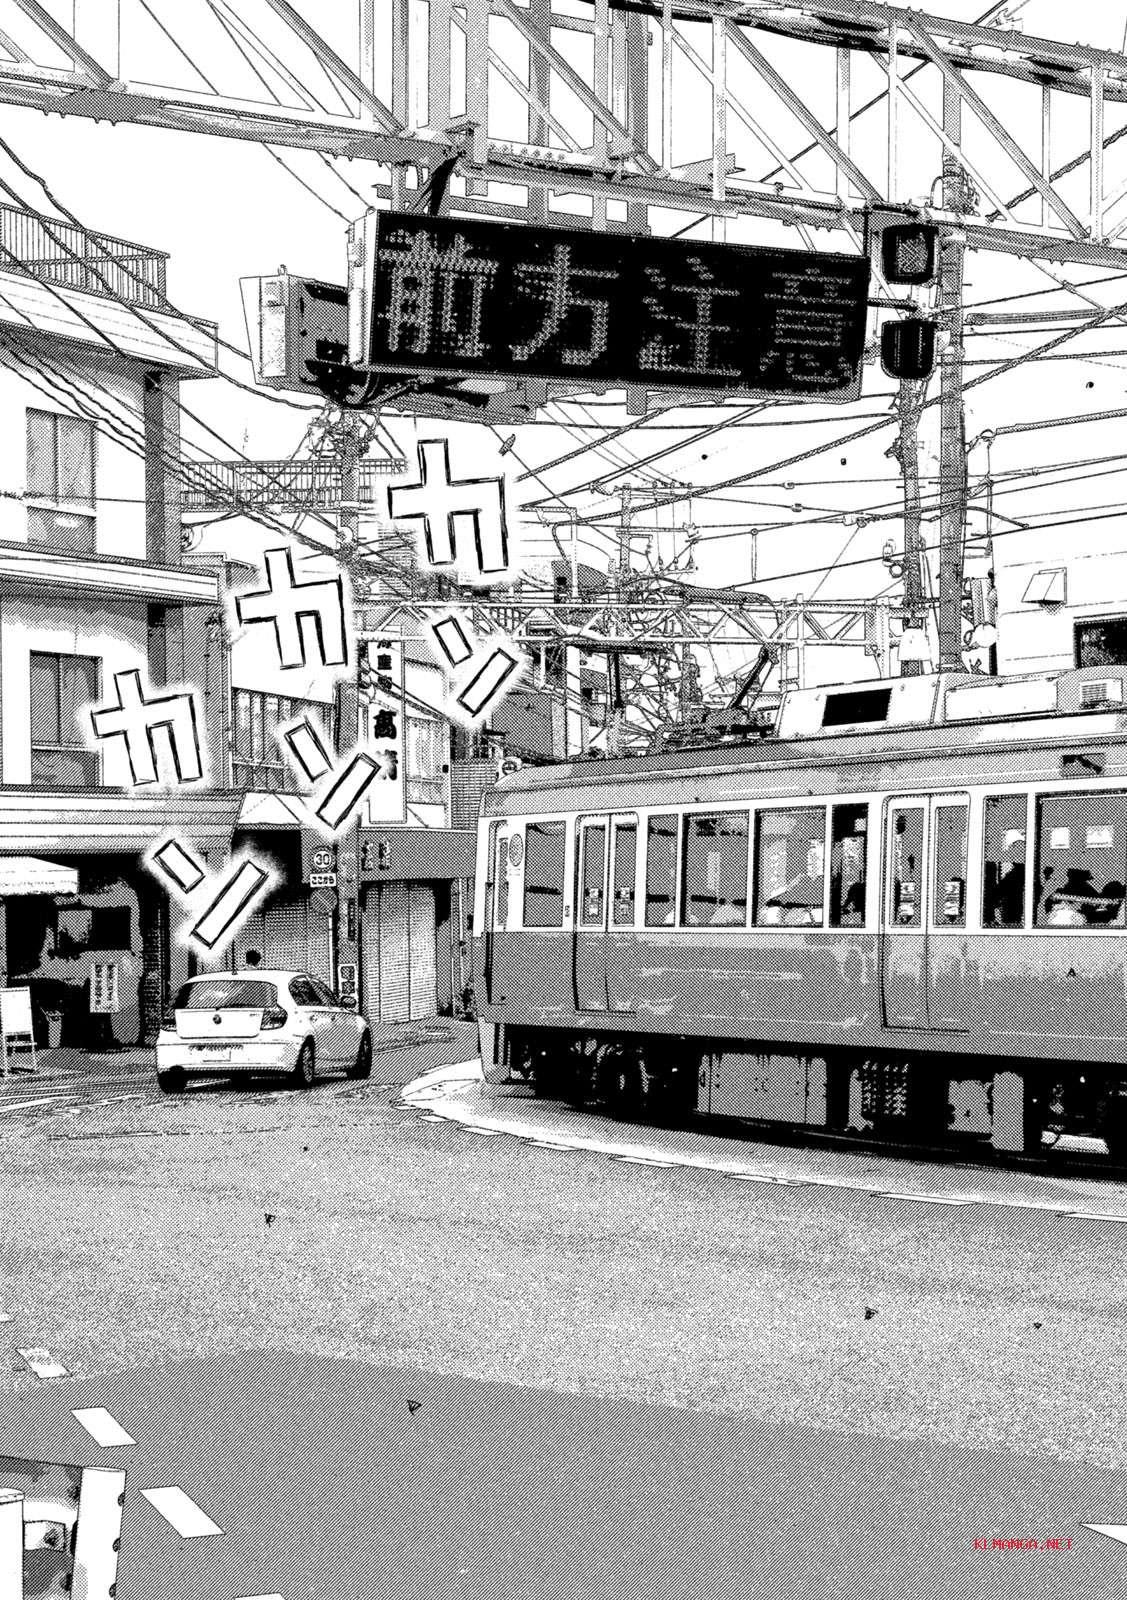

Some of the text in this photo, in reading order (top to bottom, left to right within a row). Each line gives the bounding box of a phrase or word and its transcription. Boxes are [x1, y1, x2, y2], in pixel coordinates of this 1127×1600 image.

[377, 229, 857, 384] 前方注意
[316, 853, 330, 866] 30
